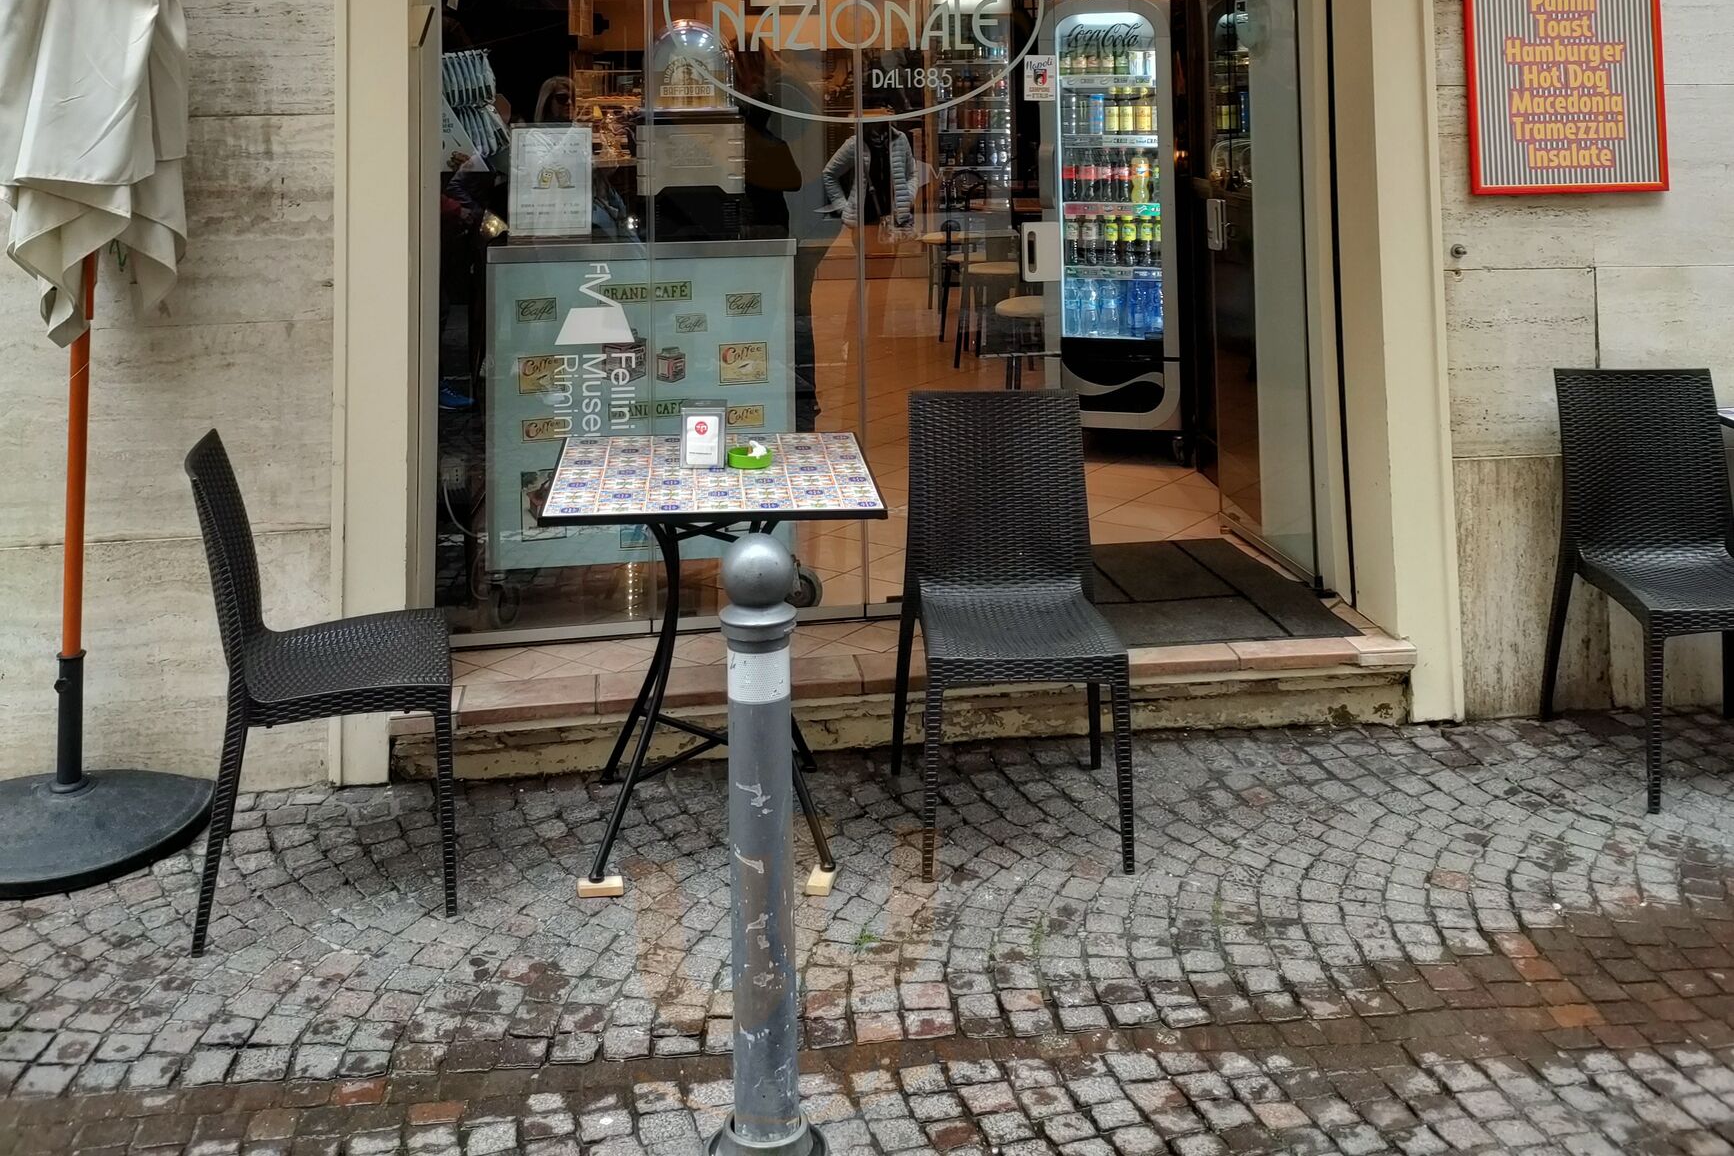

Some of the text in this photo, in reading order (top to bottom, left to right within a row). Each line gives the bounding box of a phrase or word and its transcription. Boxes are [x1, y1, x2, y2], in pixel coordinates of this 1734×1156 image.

[1535, 14, 1592, 37] Toast
[1026, 56, 1053, 70] Napoli
[1505, 40, 1624, 66] Hamburger
[871, 67, 953, 89] DAL 1885
[1523, 64, 1607, 92] Hot Dog
[1511, 90, 1623, 114] Macedonia
[1512, 114, 1624, 140] Tramezzini
[1528, 144, 1612, 168] Insalate
[722, 345, 763, 366] Coffee
[554, 355, 578, 437] Rimini
[611, 352, 636, 430] Fellini
[727, 407, 761, 425] Coffee
